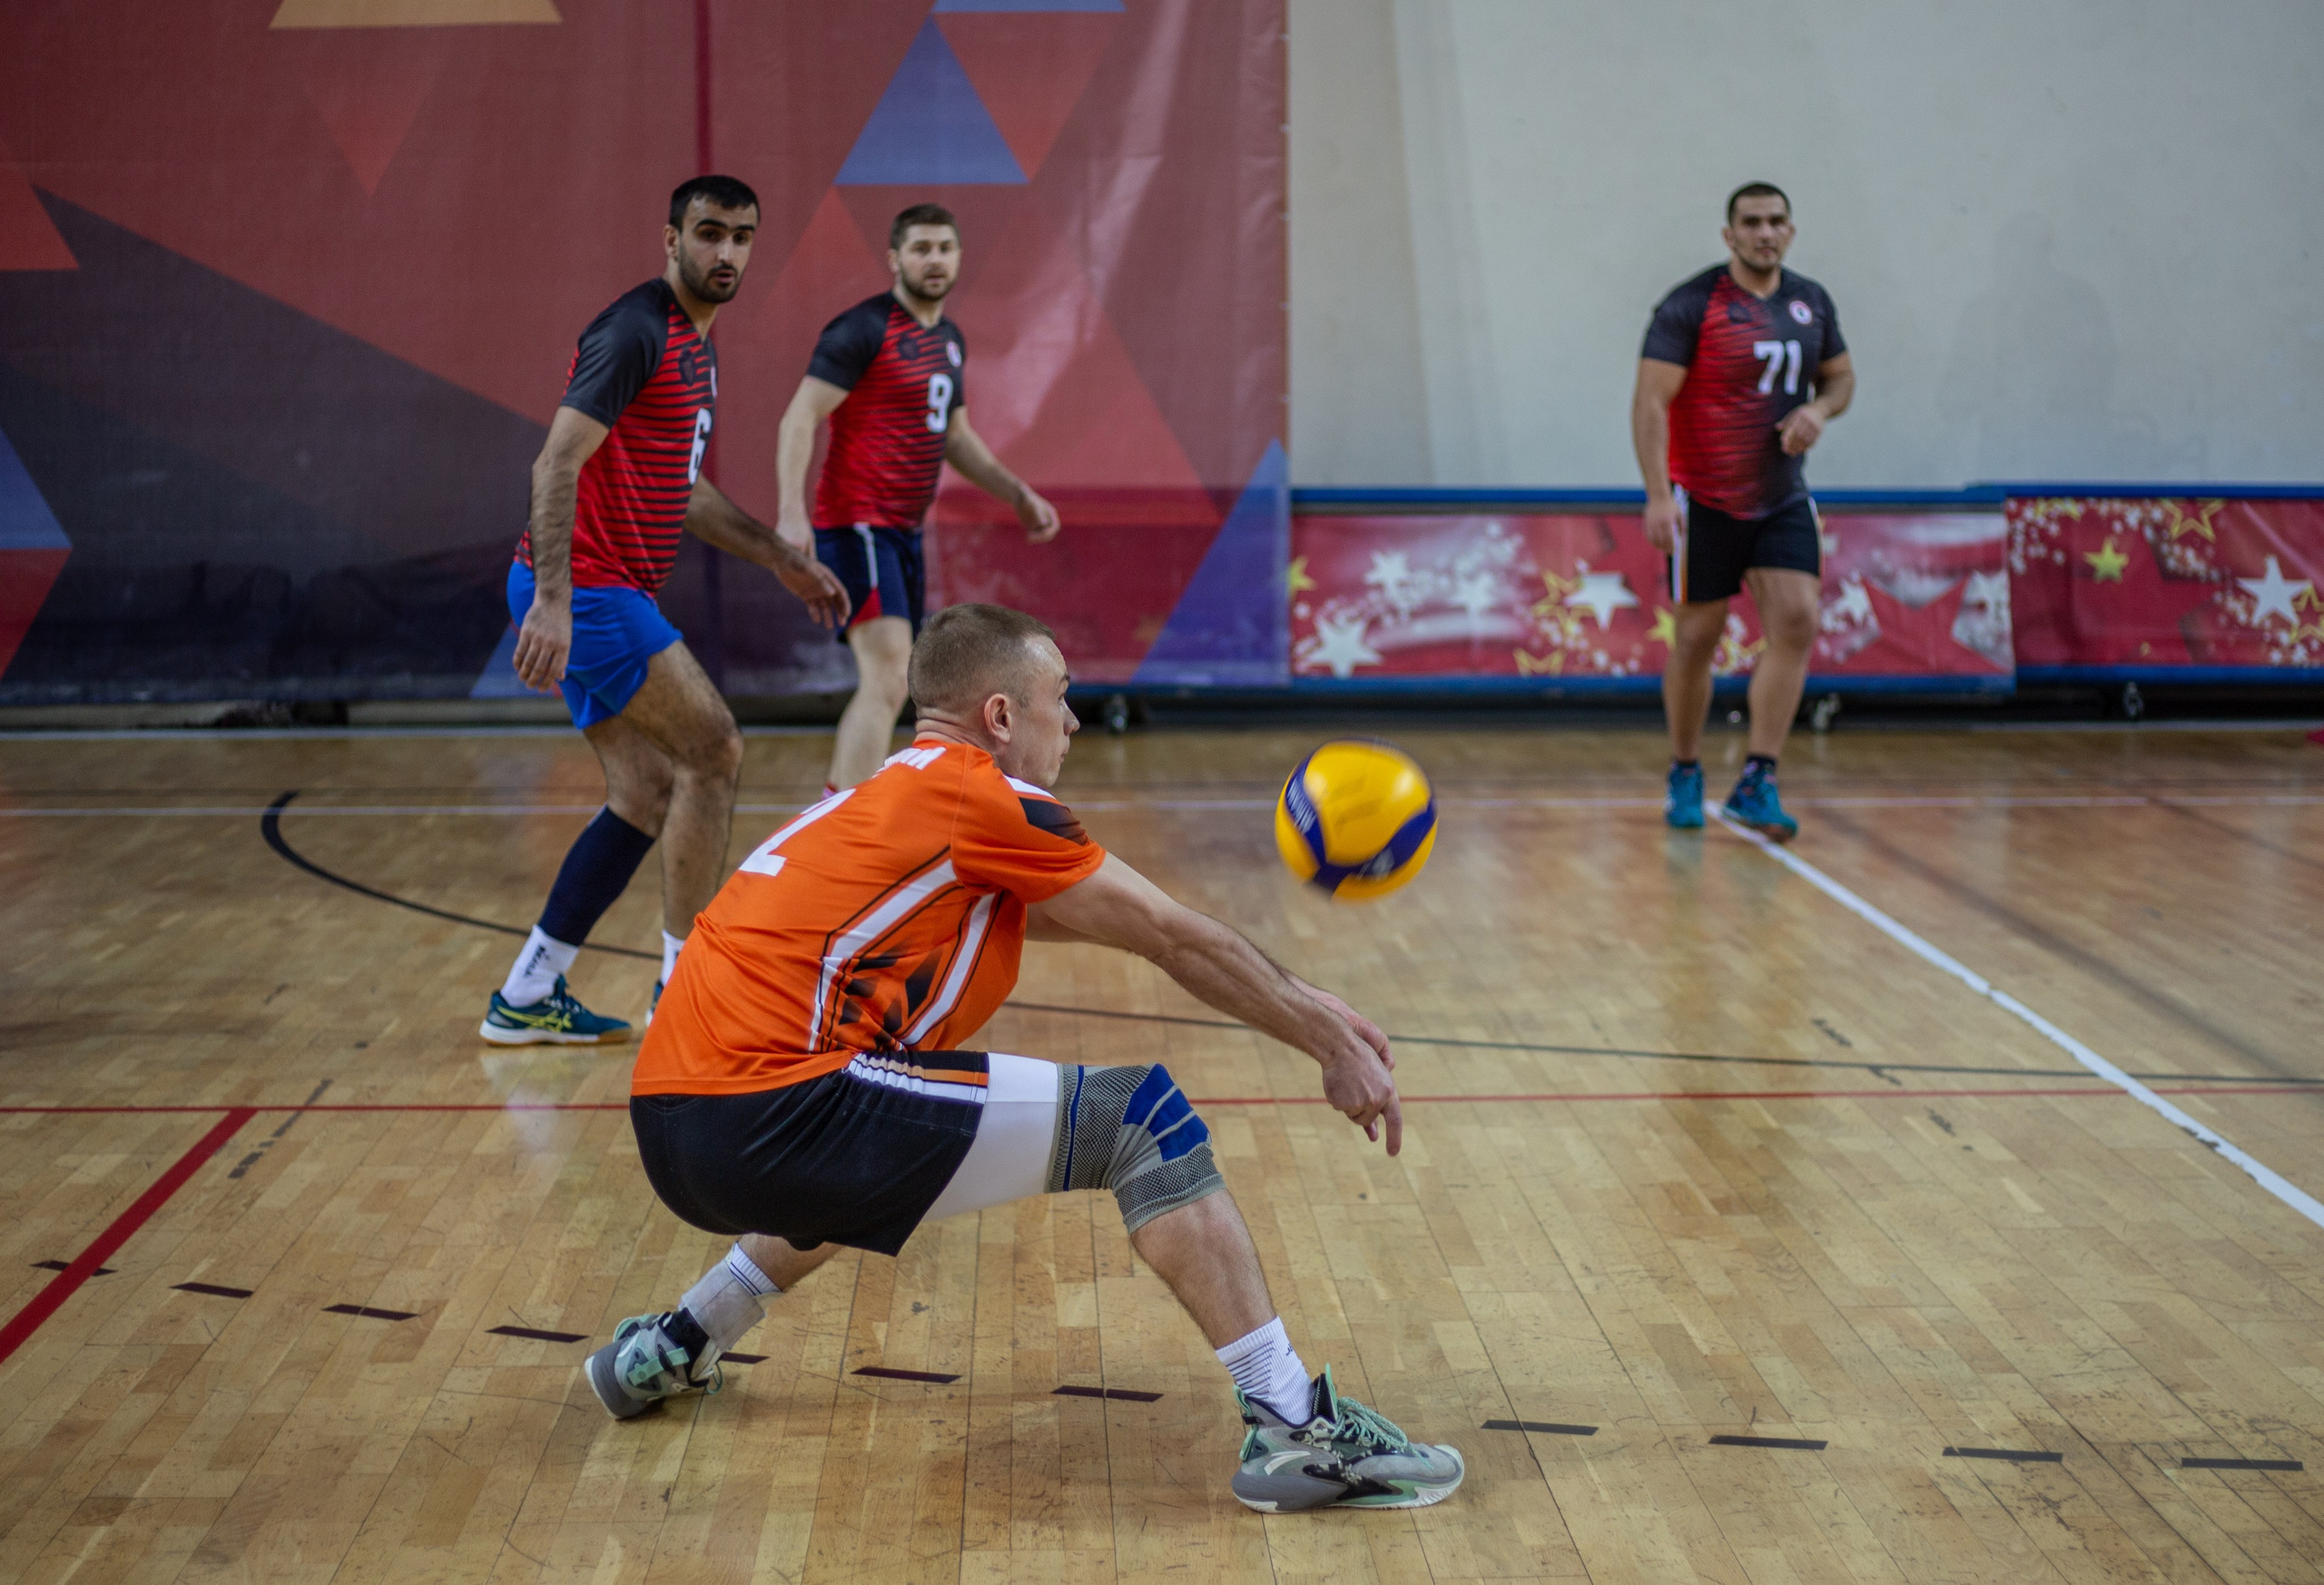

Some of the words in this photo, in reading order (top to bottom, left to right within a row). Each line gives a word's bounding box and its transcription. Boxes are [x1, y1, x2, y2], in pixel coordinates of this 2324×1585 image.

[1753, 340, 1803, 395] 71
[926, 372, 954, 434] 9
[688, 408, 713, 485] 6
